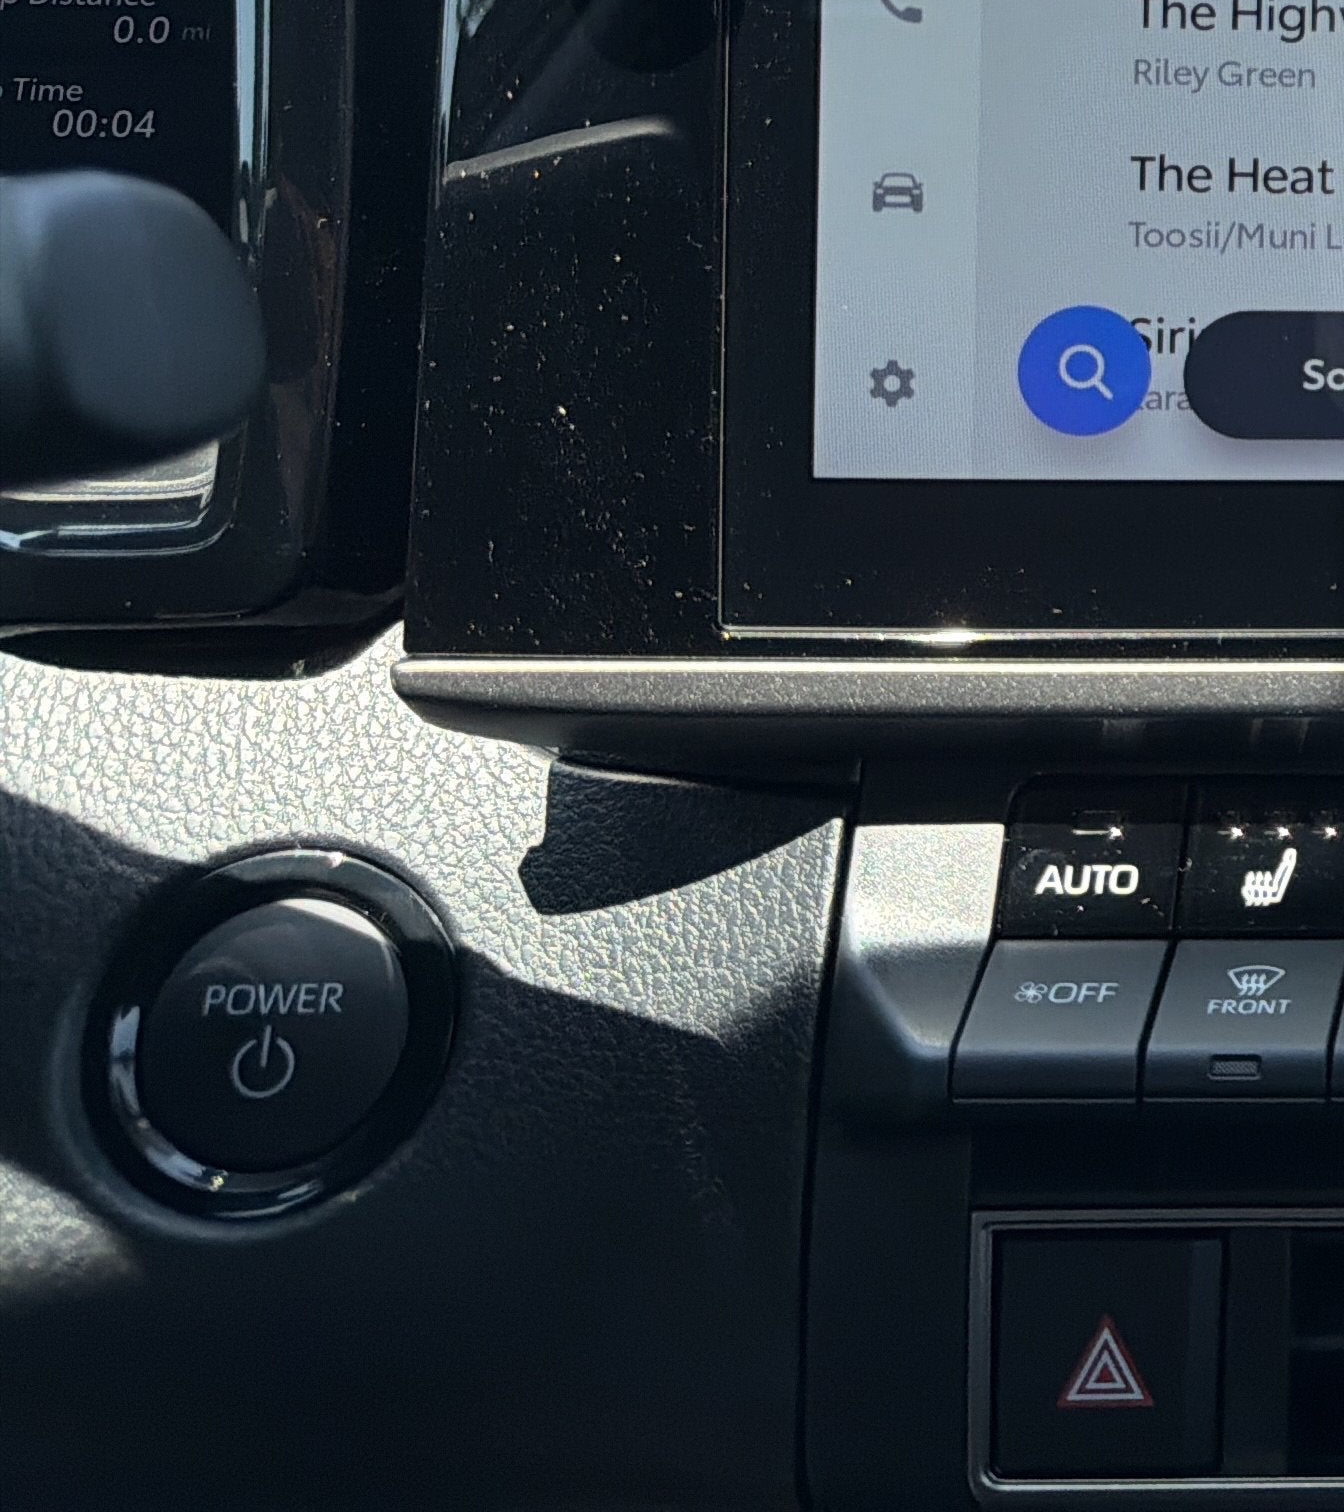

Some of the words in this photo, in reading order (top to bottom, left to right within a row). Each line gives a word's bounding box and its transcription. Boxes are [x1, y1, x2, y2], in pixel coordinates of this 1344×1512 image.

[113, 16, 170, 44] 0.0
[13, 77, 84, 102] Time
[1132, 58, 1209, 93] Riley
[1217, 61, 1316, 89] Green
[52, 109, 156, 139] 00:04
[1130, 155, 1213, 192] The
[1227, 156, 1336, 195] Heat
[1129, 220, 1316, 254] Toosii/Muni
[1036, 864, 1139, 895] AUTO
[202, 982, 343, 1016] POWER
[1049, 982, 1119, 1002] OFF
[1207, 998, 1291, 1015] FRONT
